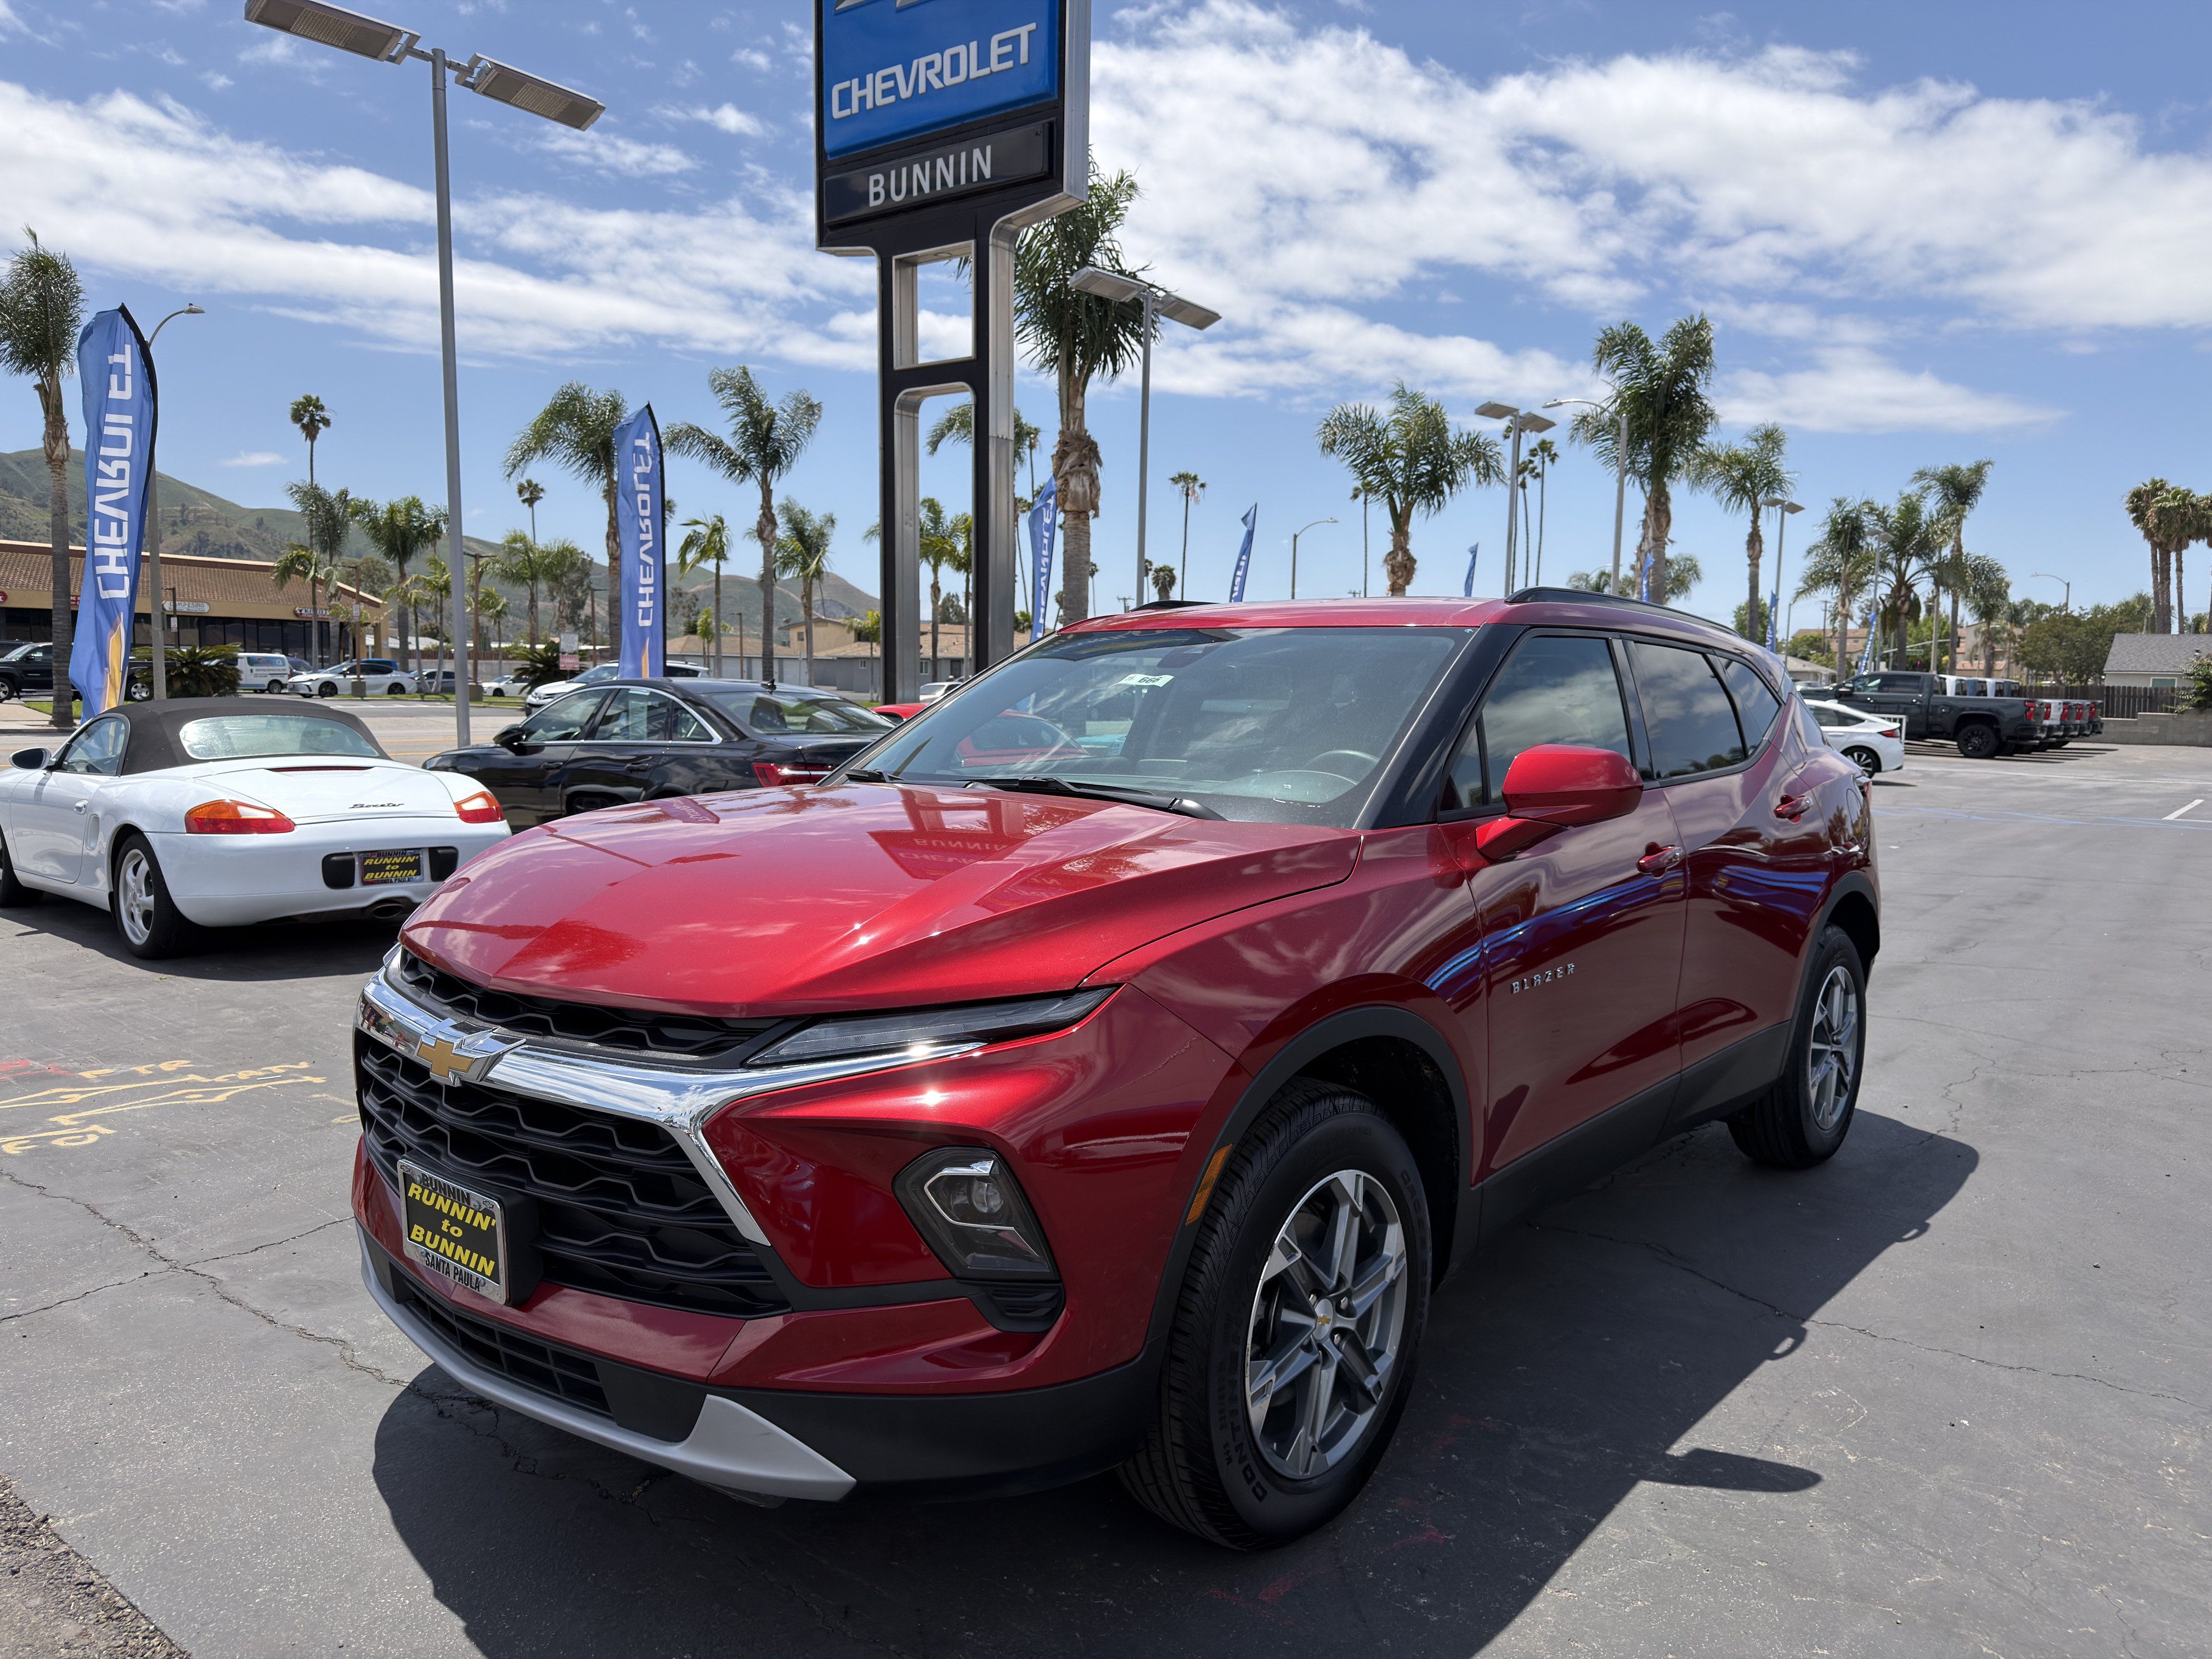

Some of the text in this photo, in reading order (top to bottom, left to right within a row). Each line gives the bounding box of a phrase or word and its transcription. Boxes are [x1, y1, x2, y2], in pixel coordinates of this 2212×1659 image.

[831, 22, 1037, 120] CHEVROLET
[868, 145, 992, 207] BUNNIN
[364, 856, 419, 866] RUNNIN'
[364, 870, 417, 879] BUNNIN
[1511, 963, 1575, 994] BLAZER
[408, 1182, 496, 1231] RUNNIN'
[421, 1171, 471, 1206] BUNNIN
[441, 1219, 463, 1237] to
[410, 1224, 495, 1277] BUNNIN
[425, 1252, 481, 1293] SANTA PAULA
